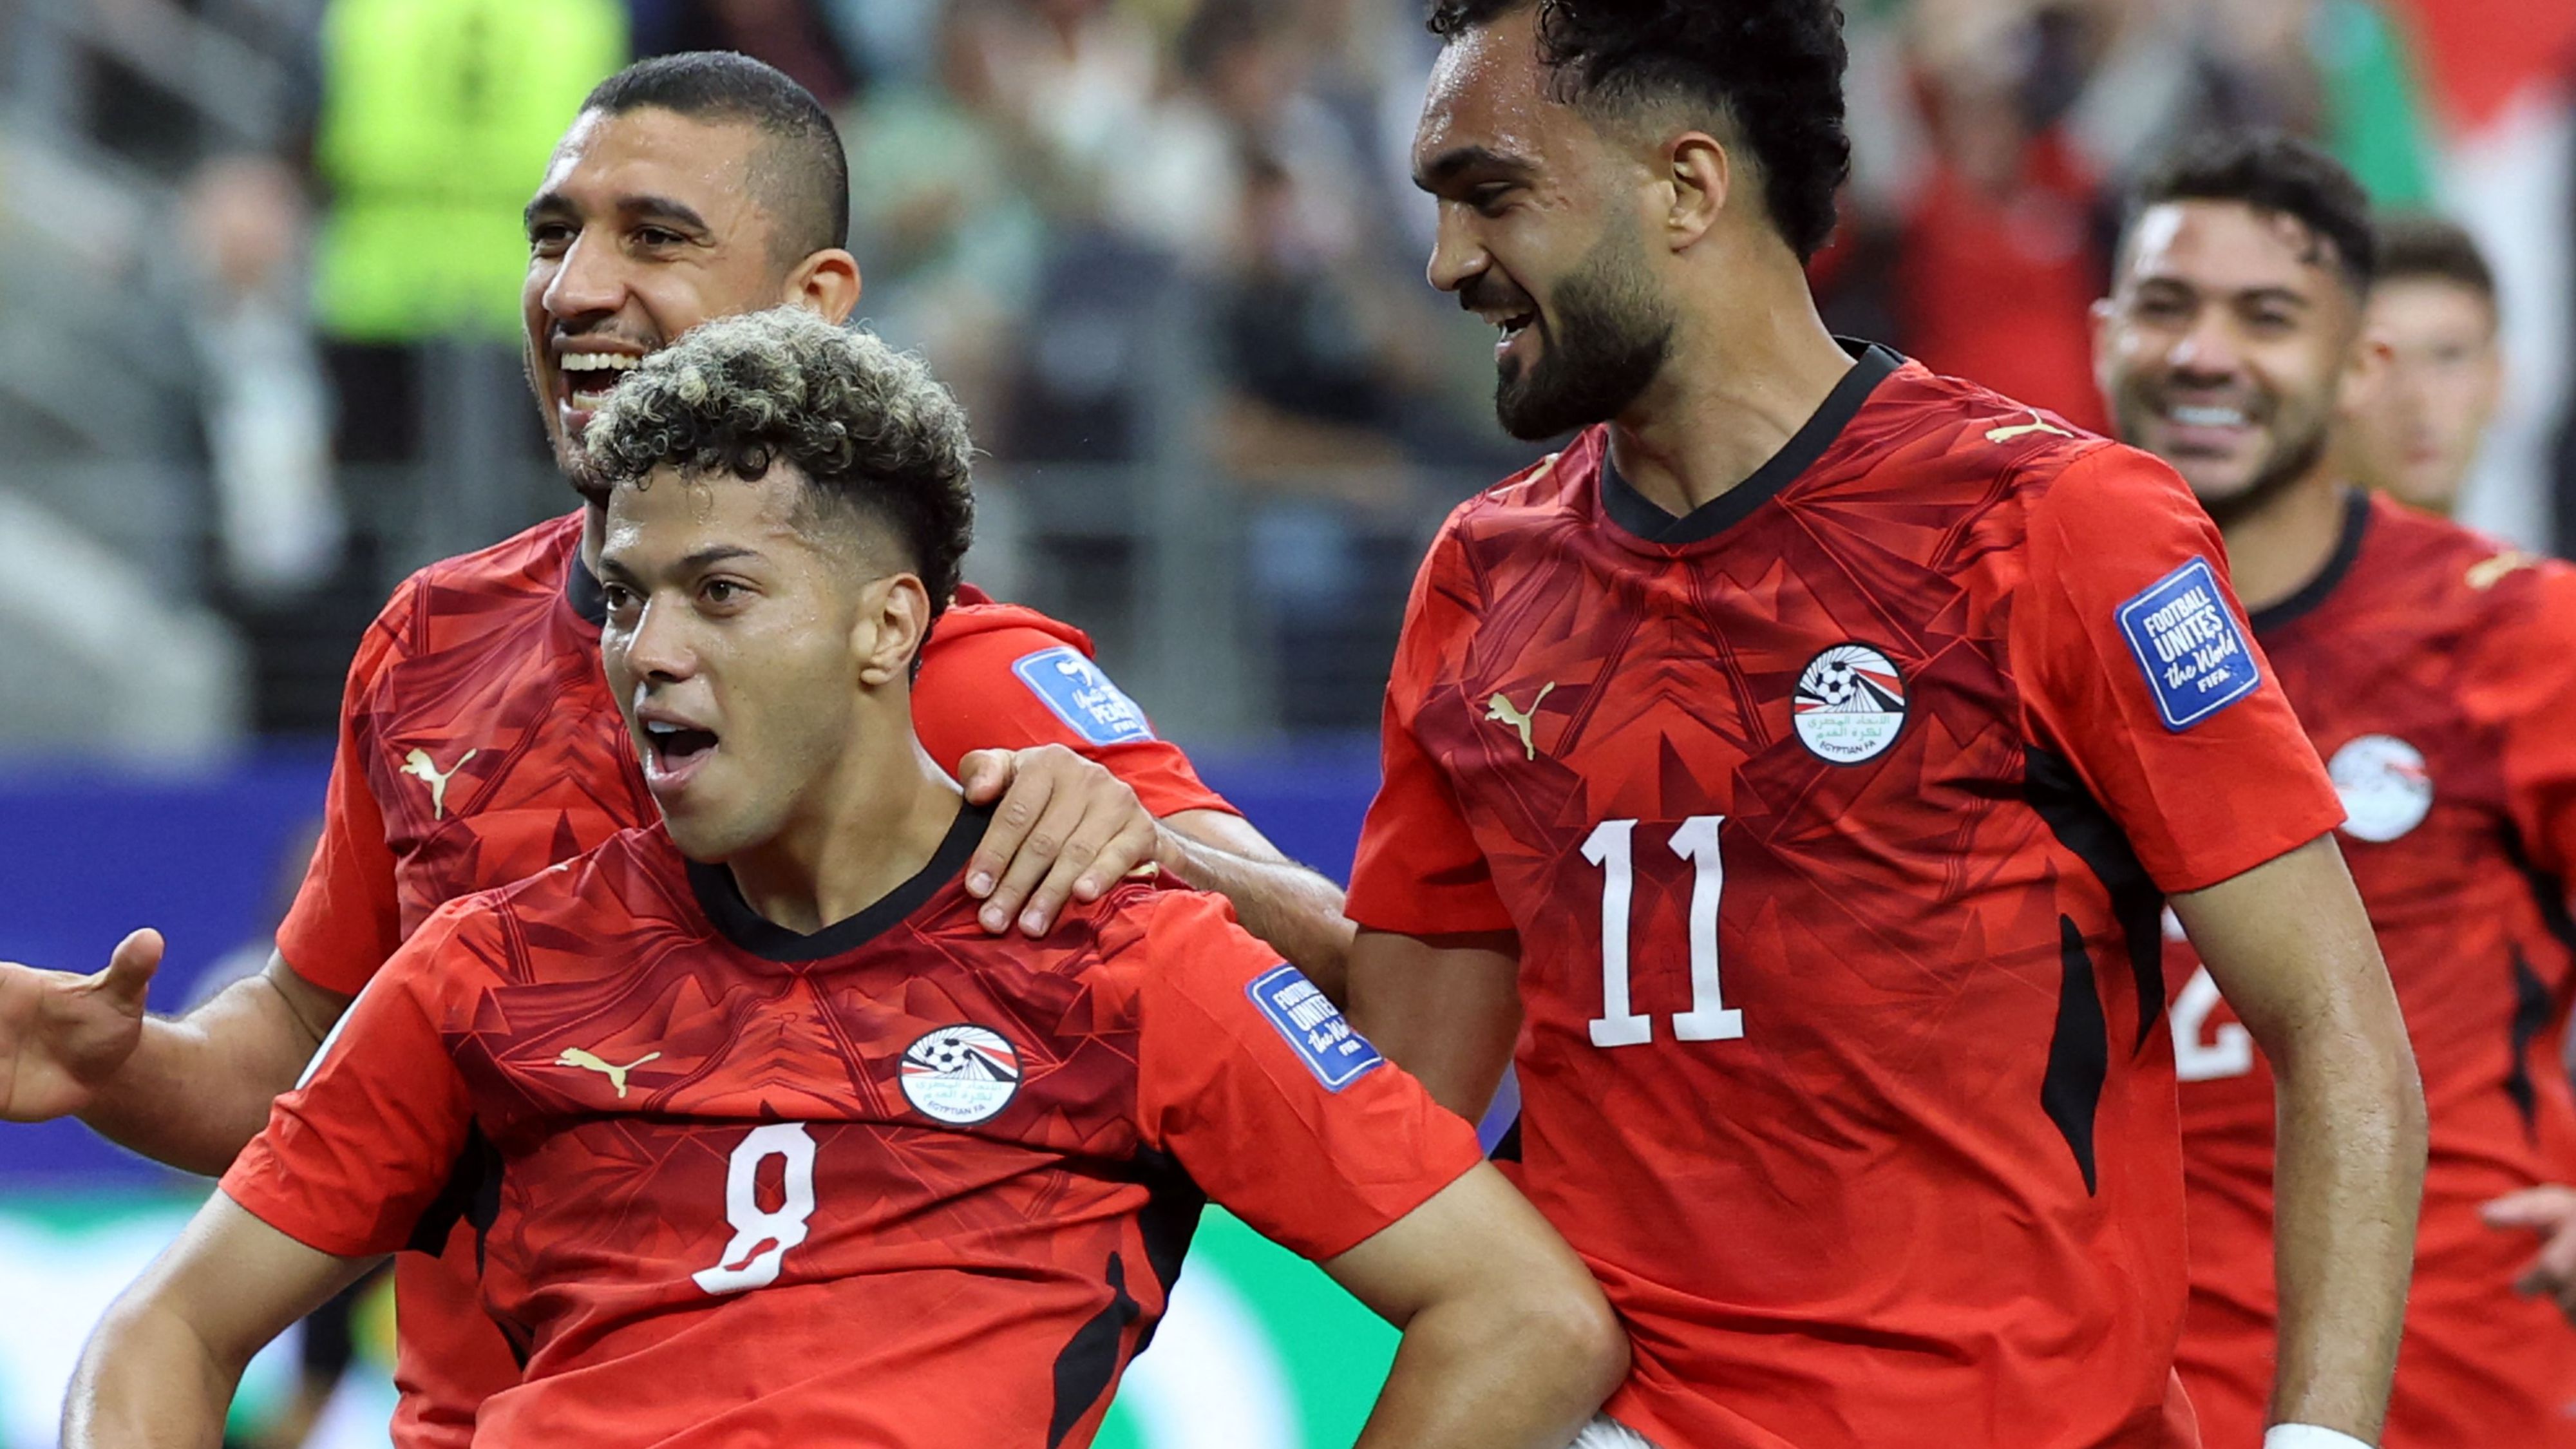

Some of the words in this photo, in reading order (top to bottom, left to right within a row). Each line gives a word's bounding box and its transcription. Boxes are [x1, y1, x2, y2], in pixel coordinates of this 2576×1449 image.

[2143, 585, 2211, 638] FOOTBALL
[2154, 605, 2223, 663] UNITES
[2164, 662, 2196, 690] the
[2192, 629, 2239, 673] World
[2198, 665, 2231, 693] FIFA
[1820, 741, 1862, 754] EGYPTIAN
[1864, 739, 1877, 750] FA
[1580, 815, 1744, 1048] 11
[2161, 902, 2253, 1081] 2
[927, 1101, 971, 1115] EGYPTIAN
[691, 1121, 817, 1296] 8
